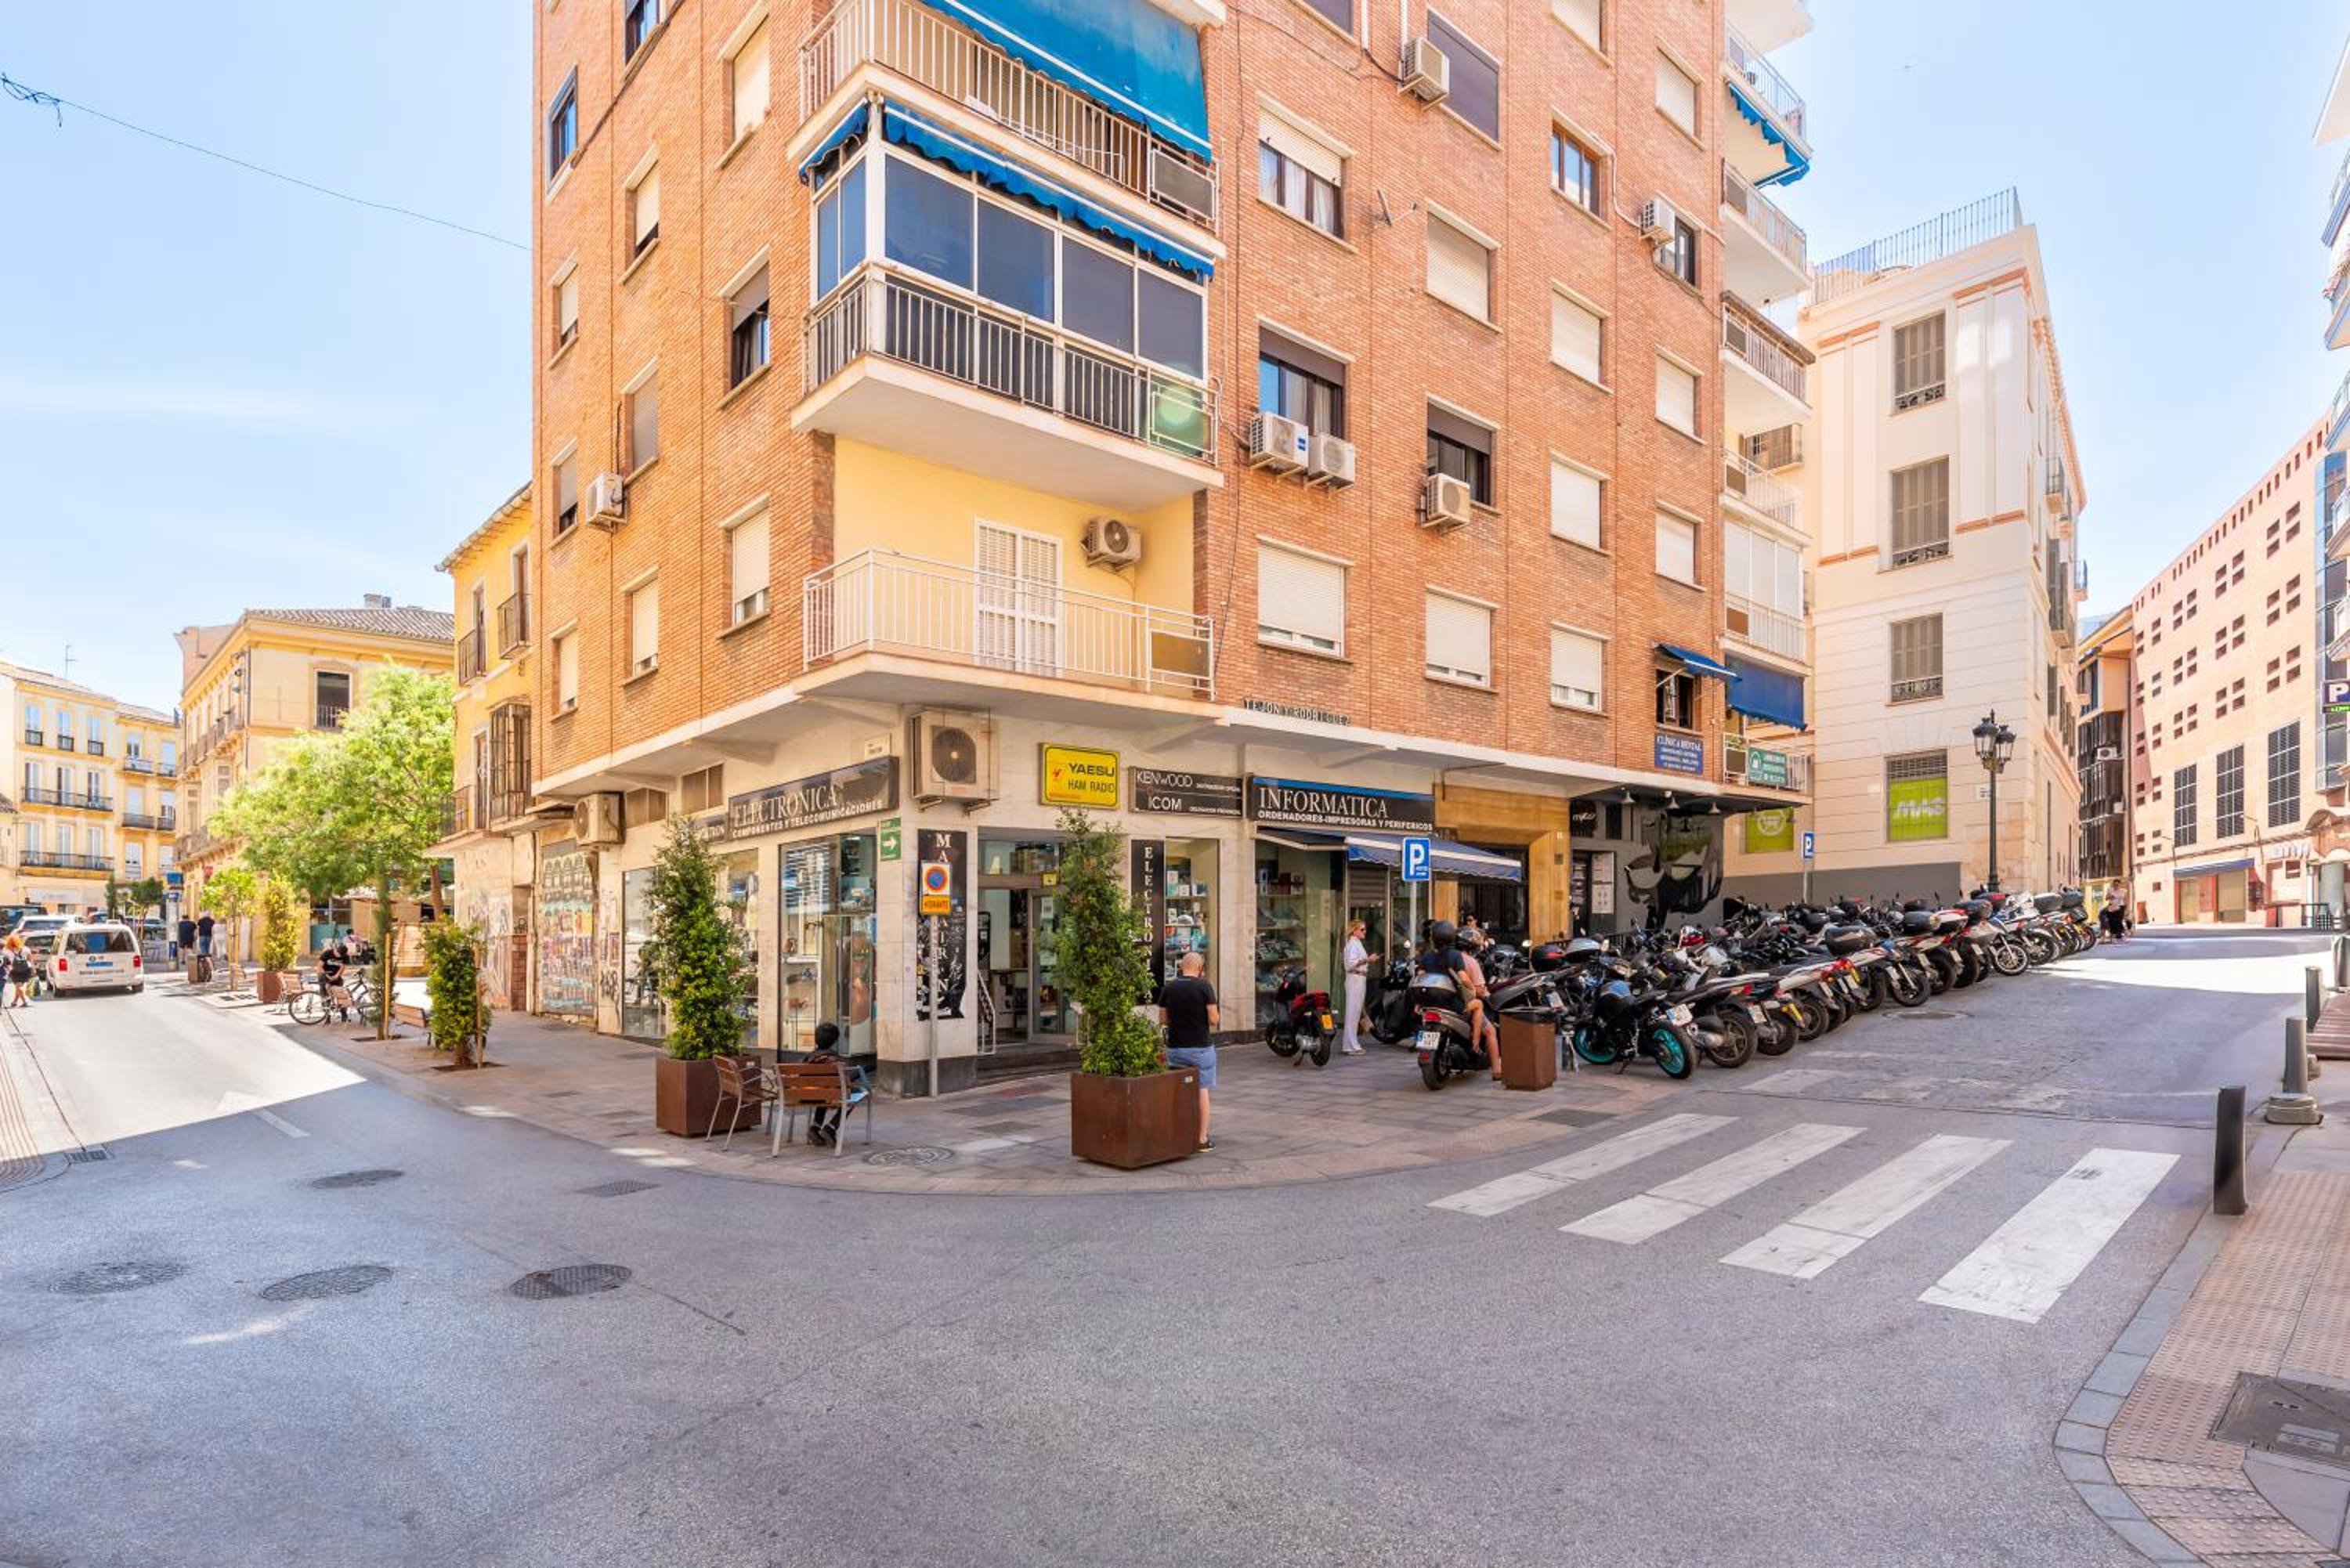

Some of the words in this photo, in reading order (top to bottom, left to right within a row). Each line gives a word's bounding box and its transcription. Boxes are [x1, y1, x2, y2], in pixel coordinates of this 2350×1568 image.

[2329, 683, 2349, 703] P
[1068, 763, 1115, 777] YAESU
[1137, 771, 1193, 787] KENWOOD
[1068, 779, 1086, 791] HAM
[1090, 782, 1115, 793] RADIO
[733, 784, 838, 827] ELECTRONICA
[1260, 788, 1388, 818] INFORMATICA
[732, 822, 783, 838] COMPONENTES
[790, 800, 884, 827] TELECOMUNICACIONES
[1378, 819, 1384, 828] Y
[1385, 820, 1433, 831] PERIFERICOS
[1410, 844, 1424, 876] P
